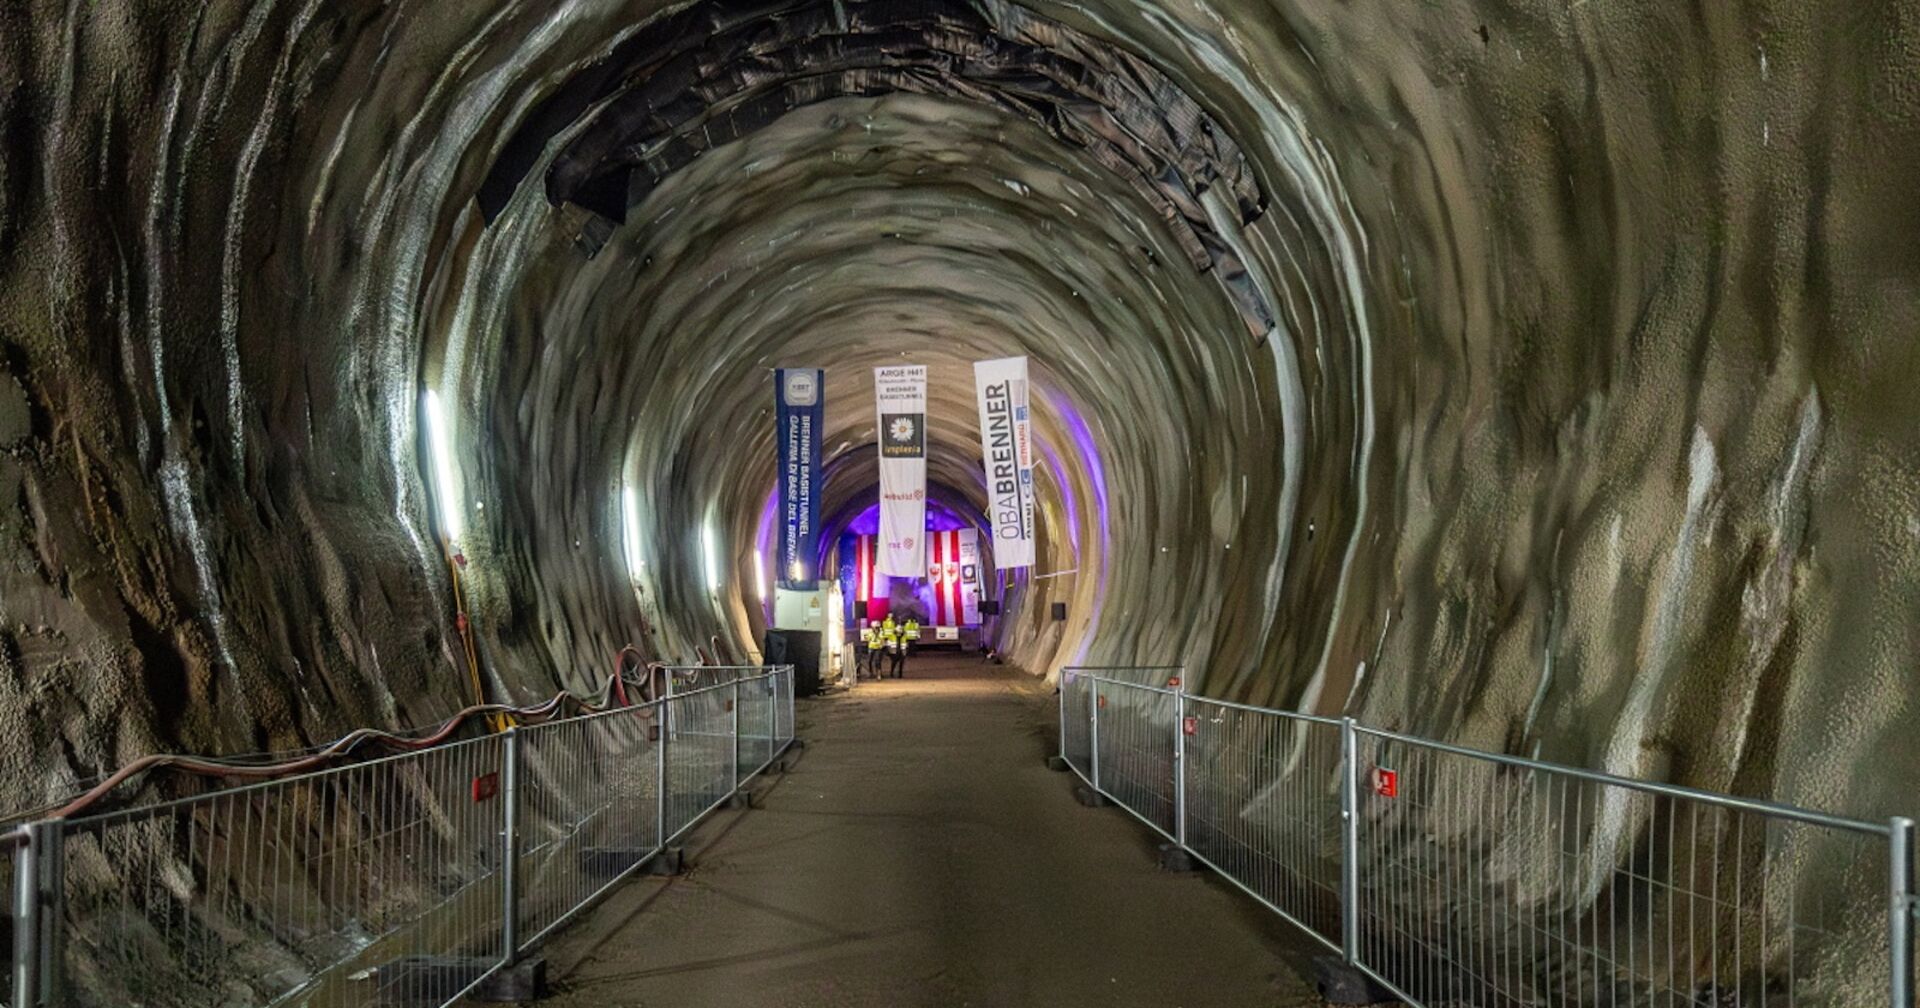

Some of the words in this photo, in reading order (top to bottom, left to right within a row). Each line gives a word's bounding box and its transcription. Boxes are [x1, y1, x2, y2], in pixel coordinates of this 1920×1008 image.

[880, 369, 905, 377] ARGE
[907, 368, 923, 376] H41
[789, 415, 799, 461] GALLERIA
[801, 415, 810, 464] BRENNER
[789, 463, 797, 474] DI
[788, 475, 797, 501] BASE
[788, 502, 796, 521] DEL
[799, 466, 810, 537] BASISTUNNEL
